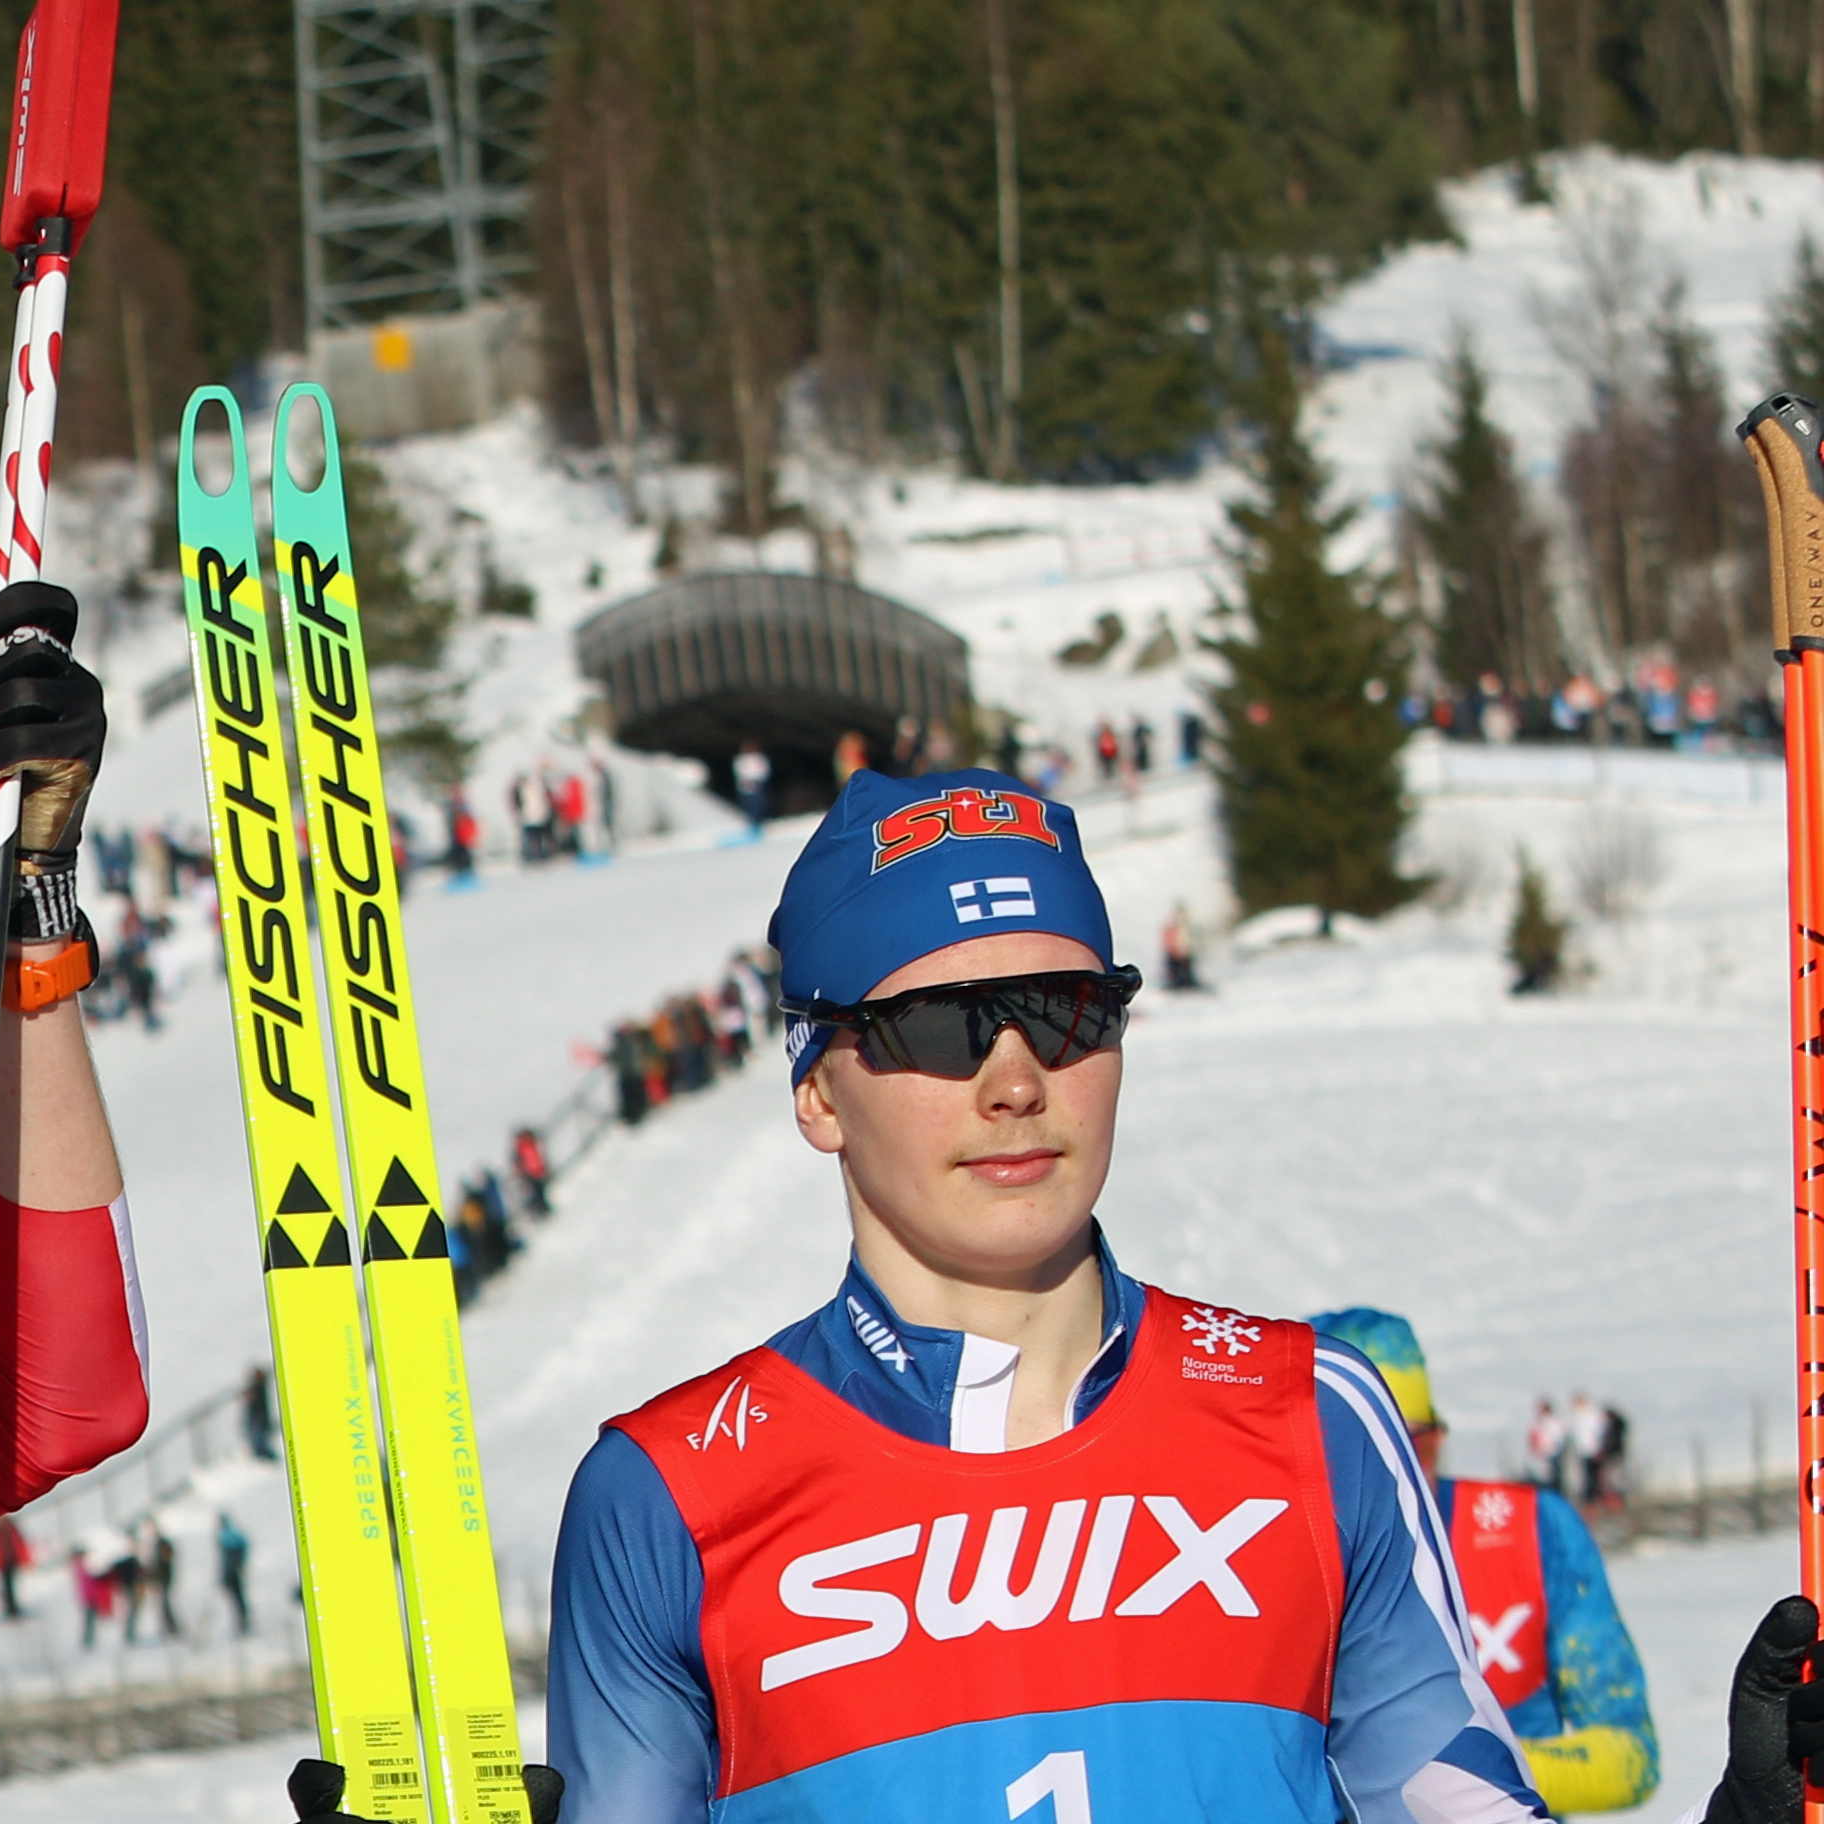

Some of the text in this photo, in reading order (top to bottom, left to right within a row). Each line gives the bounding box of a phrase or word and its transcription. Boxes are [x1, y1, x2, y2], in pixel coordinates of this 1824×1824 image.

[196, 546, 317, 1118] FISCHER
[292, 540, 413, 1111] FISCHER
[846, 1295, 915, 1374] SWIX
[1180, 1366, 1264, 1385] Skiforbund
[1181, 1356, 1236, 1373] Norges
[345, 1396, 380, 1540] SPEEDMAX
[446, 1390, 479, 1532] SPEEDMAX
[759, 1494, 1289, 1693] SWIX
